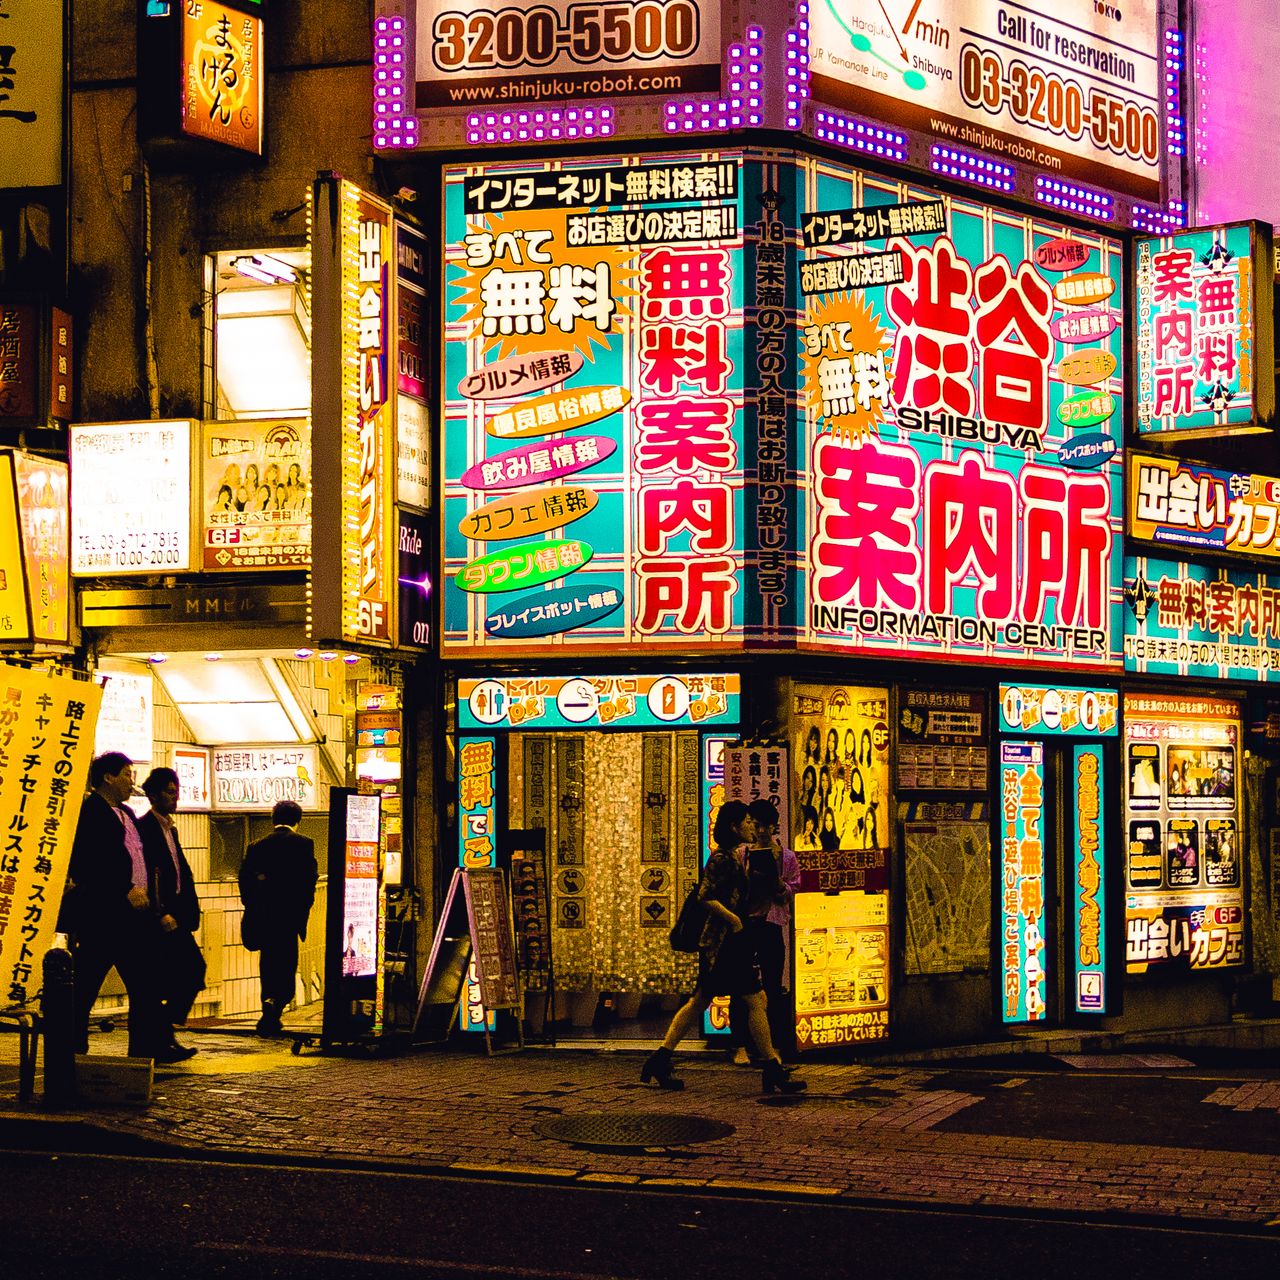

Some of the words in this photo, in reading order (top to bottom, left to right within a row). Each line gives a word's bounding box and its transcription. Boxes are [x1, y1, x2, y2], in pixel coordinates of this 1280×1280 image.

[435, 0, 699, 69] 3200-5500
[998, 9, 1027, 43] Call
[1031, 21, 1051, 51] for
[1055, 34, 1135, 83] reservation
[201, 13, 238, 127] まるげん
[813, 47, 825, 60] JR
[827, 52, 869, 75] Yamanote
[912, 55, 953, 81] Shibuya
[449, 74, 682, 101] www.shinjuku-robot.com
[961, 47, 1158, 163] 03-3200-5500
[930, 118, 1062, 170] www.shinjuku-robot.com
[466, 164, 735, 210] インターネット無料検索!!
[568, 210, 736, 245] お店選びの決定版!!
[804, 202, 944, 244] インターネット無料検索!!
[464, 230, 553, 266] すべて
[1037, 242, 1086, 267] グルメ情報
[801, 252, 903, 293] お店選びの決定版!!
[481, 262, 615, 337] 無料
[804, 322, 854, 355] すべて
[886, 239, 1054, 433] 渋谷
[1058, 314, 1110, 339] 飲み屋情報
[1152, 249, 1196, 419] 案内所
[1197, 276, 1237, 384] 無料
[466, 354, 573, 398] グルメ情報
[816, 349, 891, 418] 無料
[493, 389, 624, 436] 優良風俗情報
[756, 220, 787, 608] 18歳未満の方の入場はお断り致します。
[897, 407, 1043, 453] SHIBUYA
[481, 436, 601, 486] 飲み屋情報
[635, 247, 737, 635] 無料案内所
[470, 489, 589, 535] カフェ情報
[1137, 467, 1227, 528] 出会い
[399, 525, 422, 555] Ride
[814, 434, 1113, 630] 案内所
[463, 544, 583, 588] タウン情報
[358, 601, 383, 635] 6F
[413, 620, 429, 644] on
[487, 591, 618, 633] プレイスポット情報
[813, 605, 1001, 644] INFORMATION
[1004, 622, 1106, 652] CENTER
[507, 679, 549, 694] トイレ
[593, 678, 637, 694] タバコ
[214, 752, 268, 772] お部屋探しは
[1019, 767, 1043, 919] 全て無料
[1077, 751, 1100, 967] お気軽にご入場ください
[1126, 917, 1190, 962] 出会い
[1190, 926, 1242, 966] カフェ
